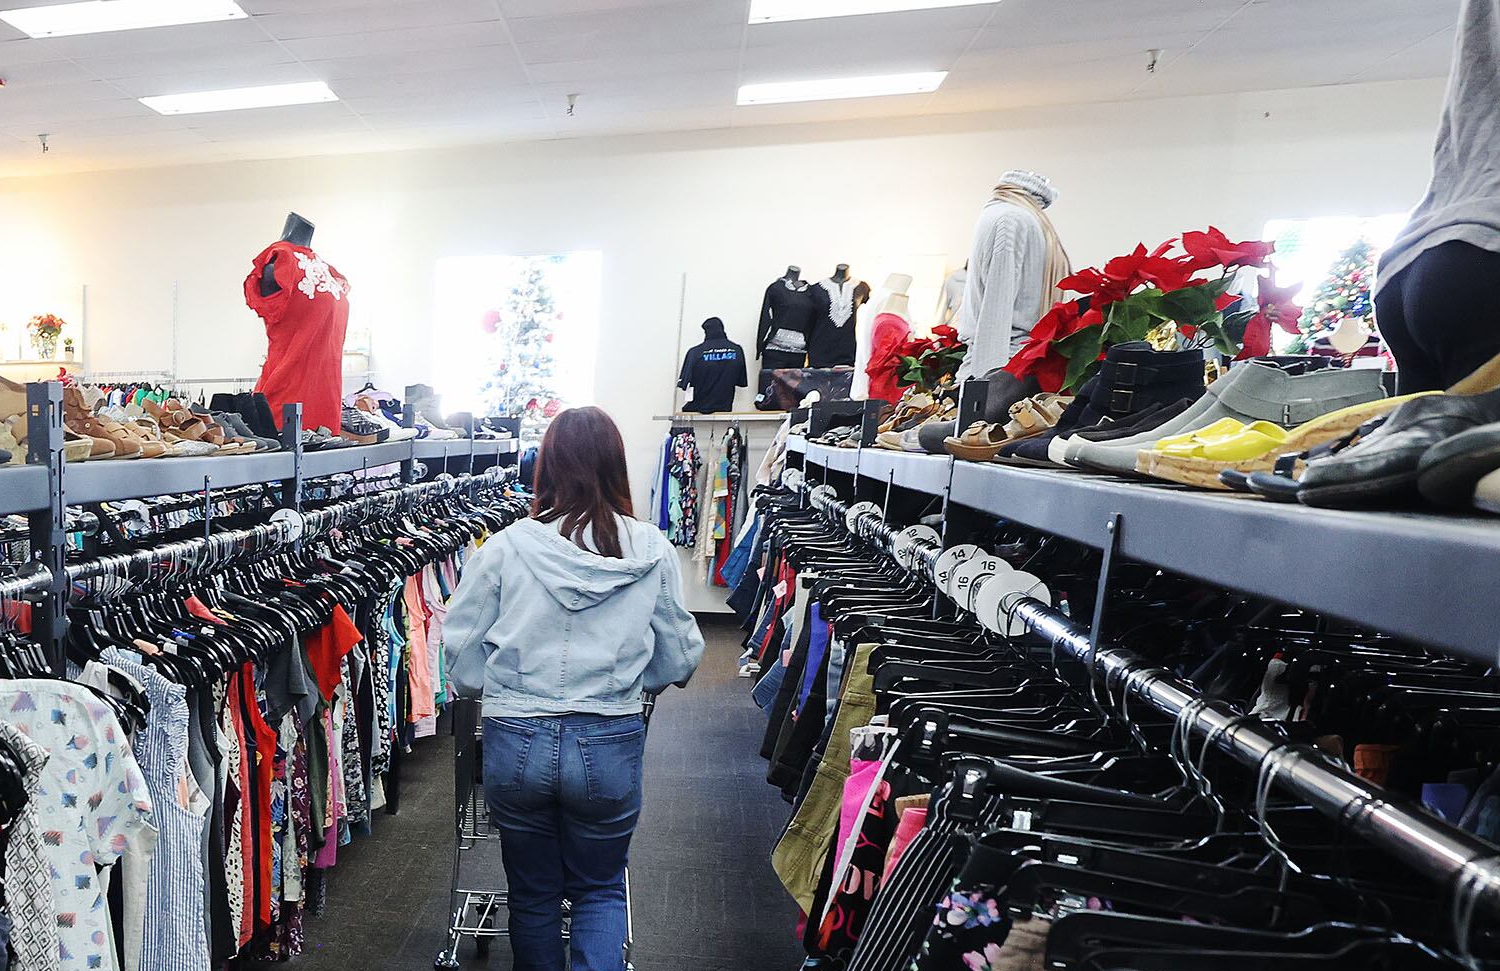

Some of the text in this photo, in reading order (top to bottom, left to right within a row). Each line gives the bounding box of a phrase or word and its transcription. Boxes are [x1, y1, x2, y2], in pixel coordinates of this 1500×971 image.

[703, 352, 736, 361] VILLAGE
[906, 528, 918, 538] 12
[951, 548, 966, 560] 14
[981, 560, 997, 571] 16
[938, 571, 948, 584] 14
[957, 576, 969, 590] 16
